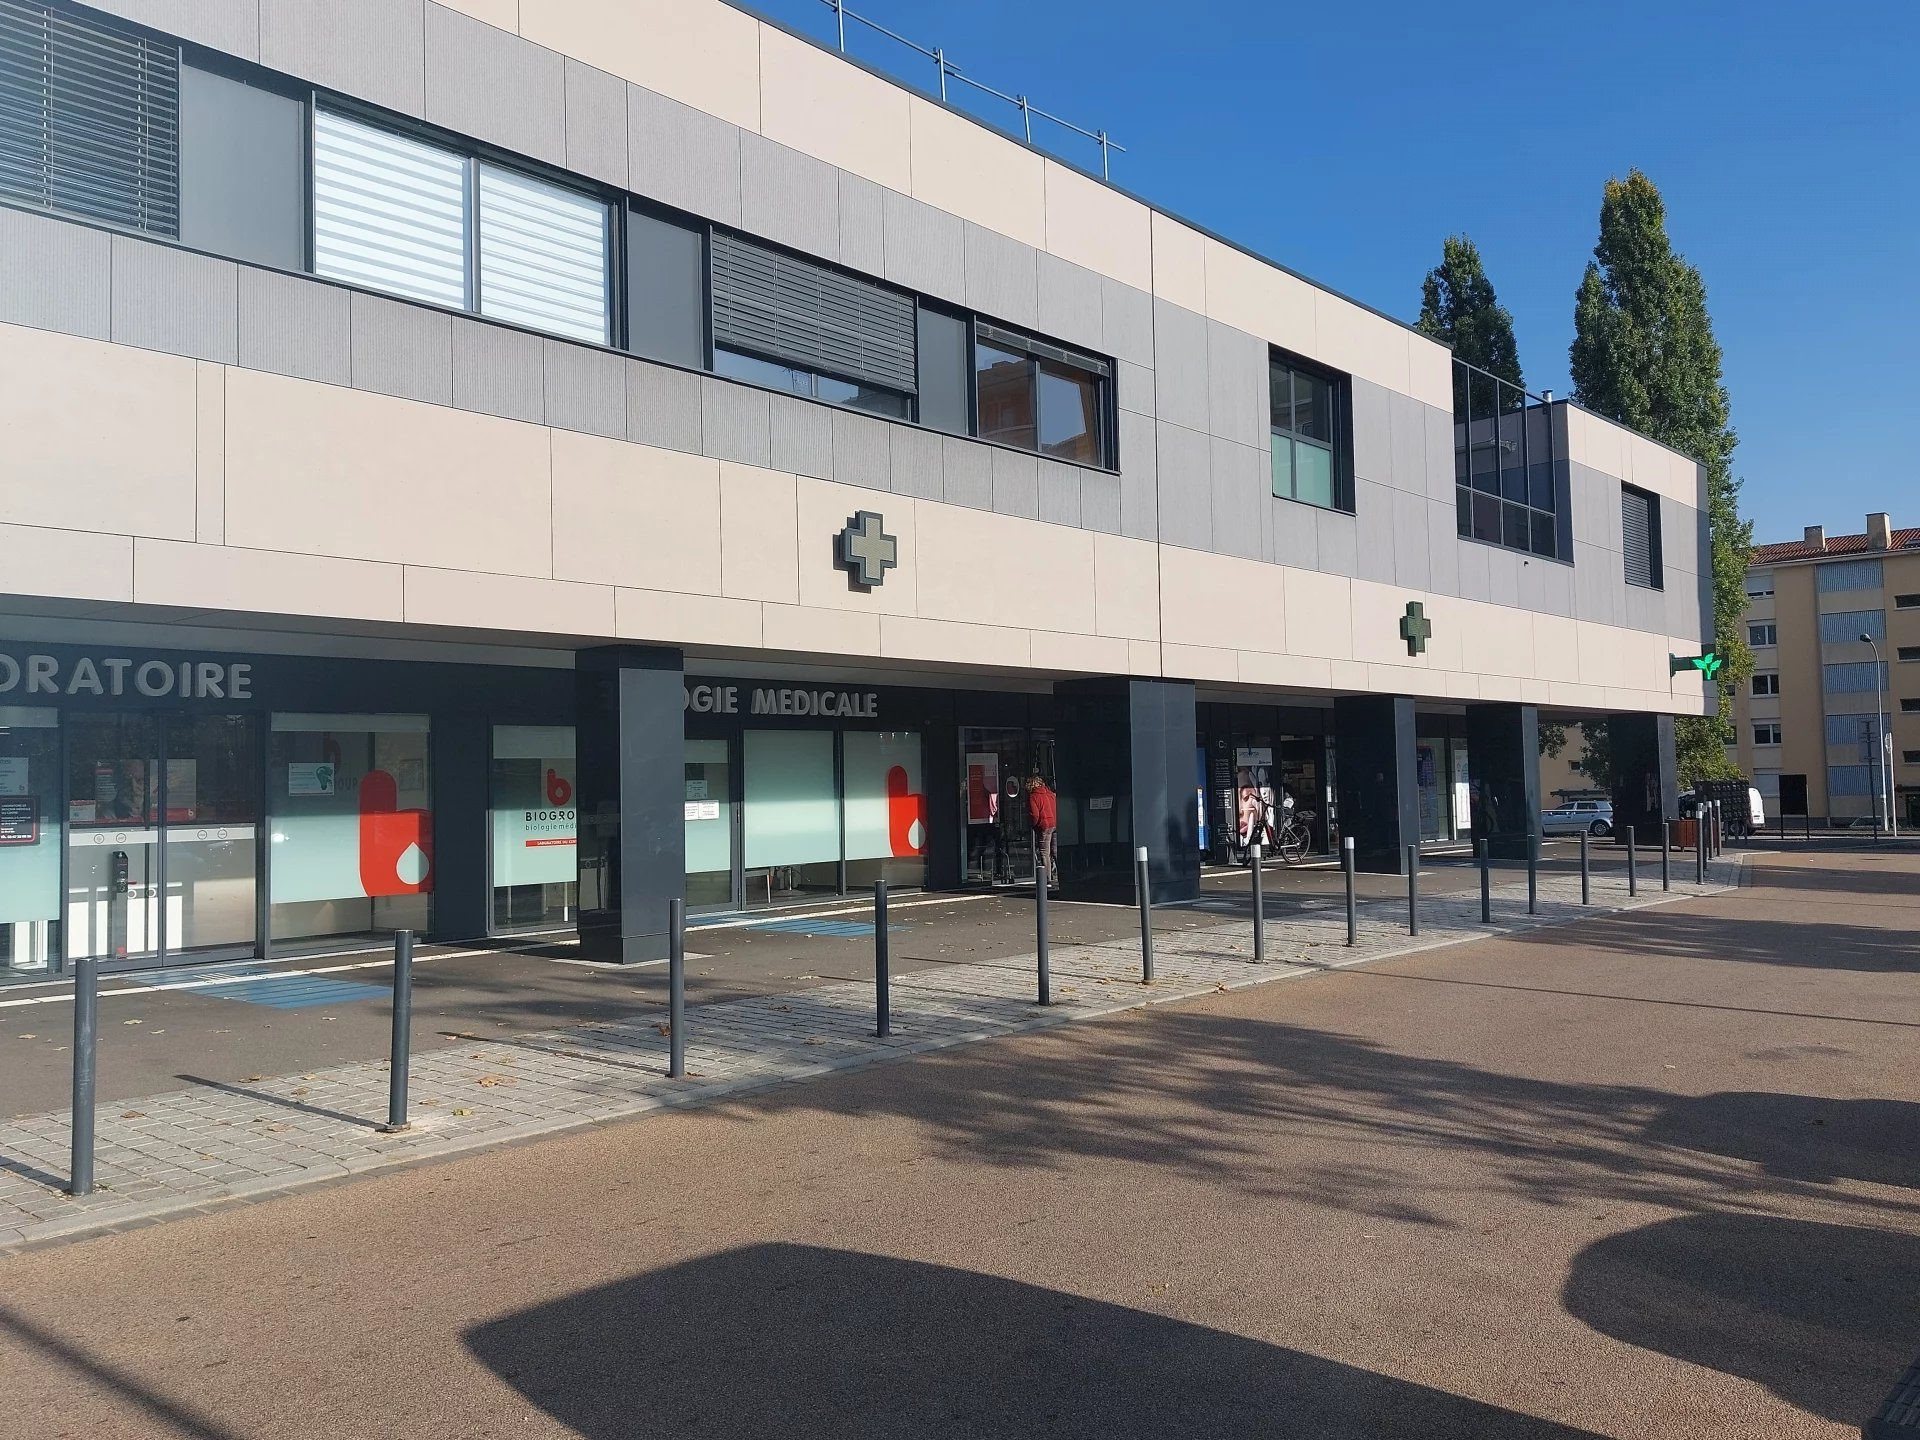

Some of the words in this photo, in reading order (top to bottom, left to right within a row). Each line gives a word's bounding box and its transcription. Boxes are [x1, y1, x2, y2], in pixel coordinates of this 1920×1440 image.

[684, 685, 739, 714] GIE
[750, 688, 878, 718] MEDICALE
[525, 810, 575, 821] BIOGRO
